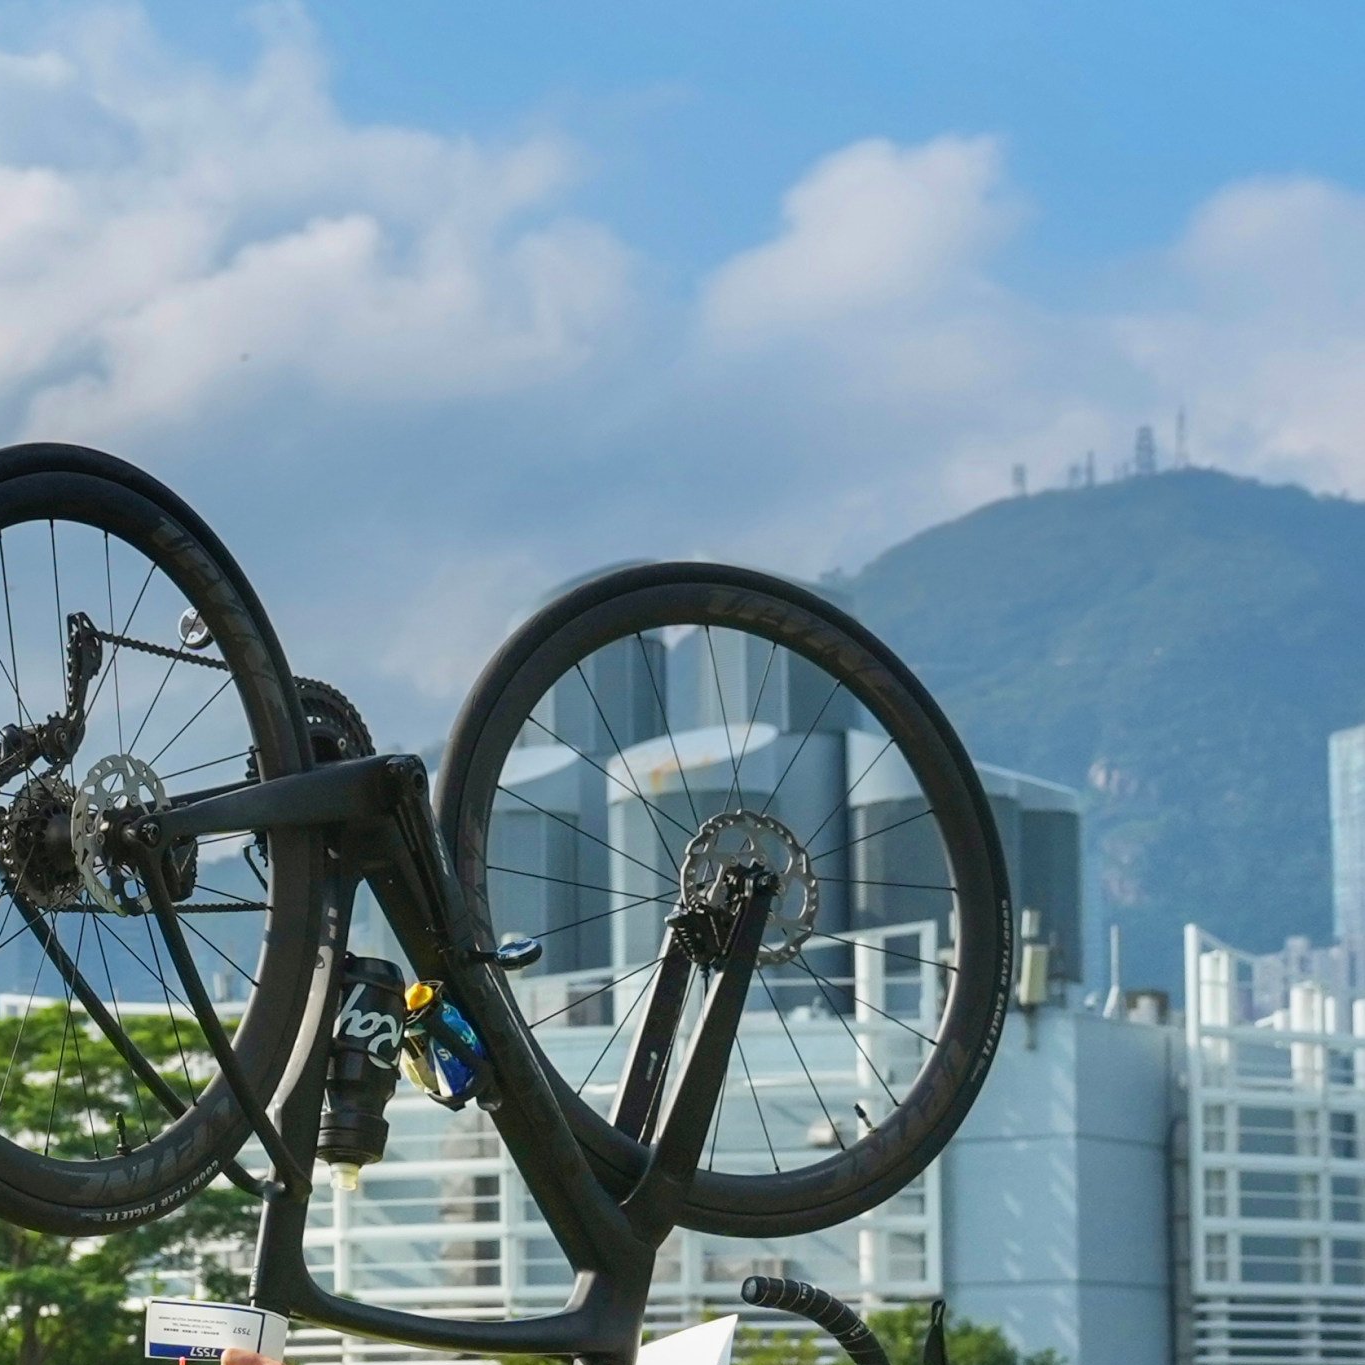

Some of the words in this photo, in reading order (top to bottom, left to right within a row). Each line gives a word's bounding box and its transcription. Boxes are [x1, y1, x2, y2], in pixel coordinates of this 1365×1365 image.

[161, 1159, 219, 1207] GOODYEAR
[121, 1203, 155, 1221] EAGLE
[233, 1327, 252, 1336] 7557
[190, 1347, 219, 1357] 7557
